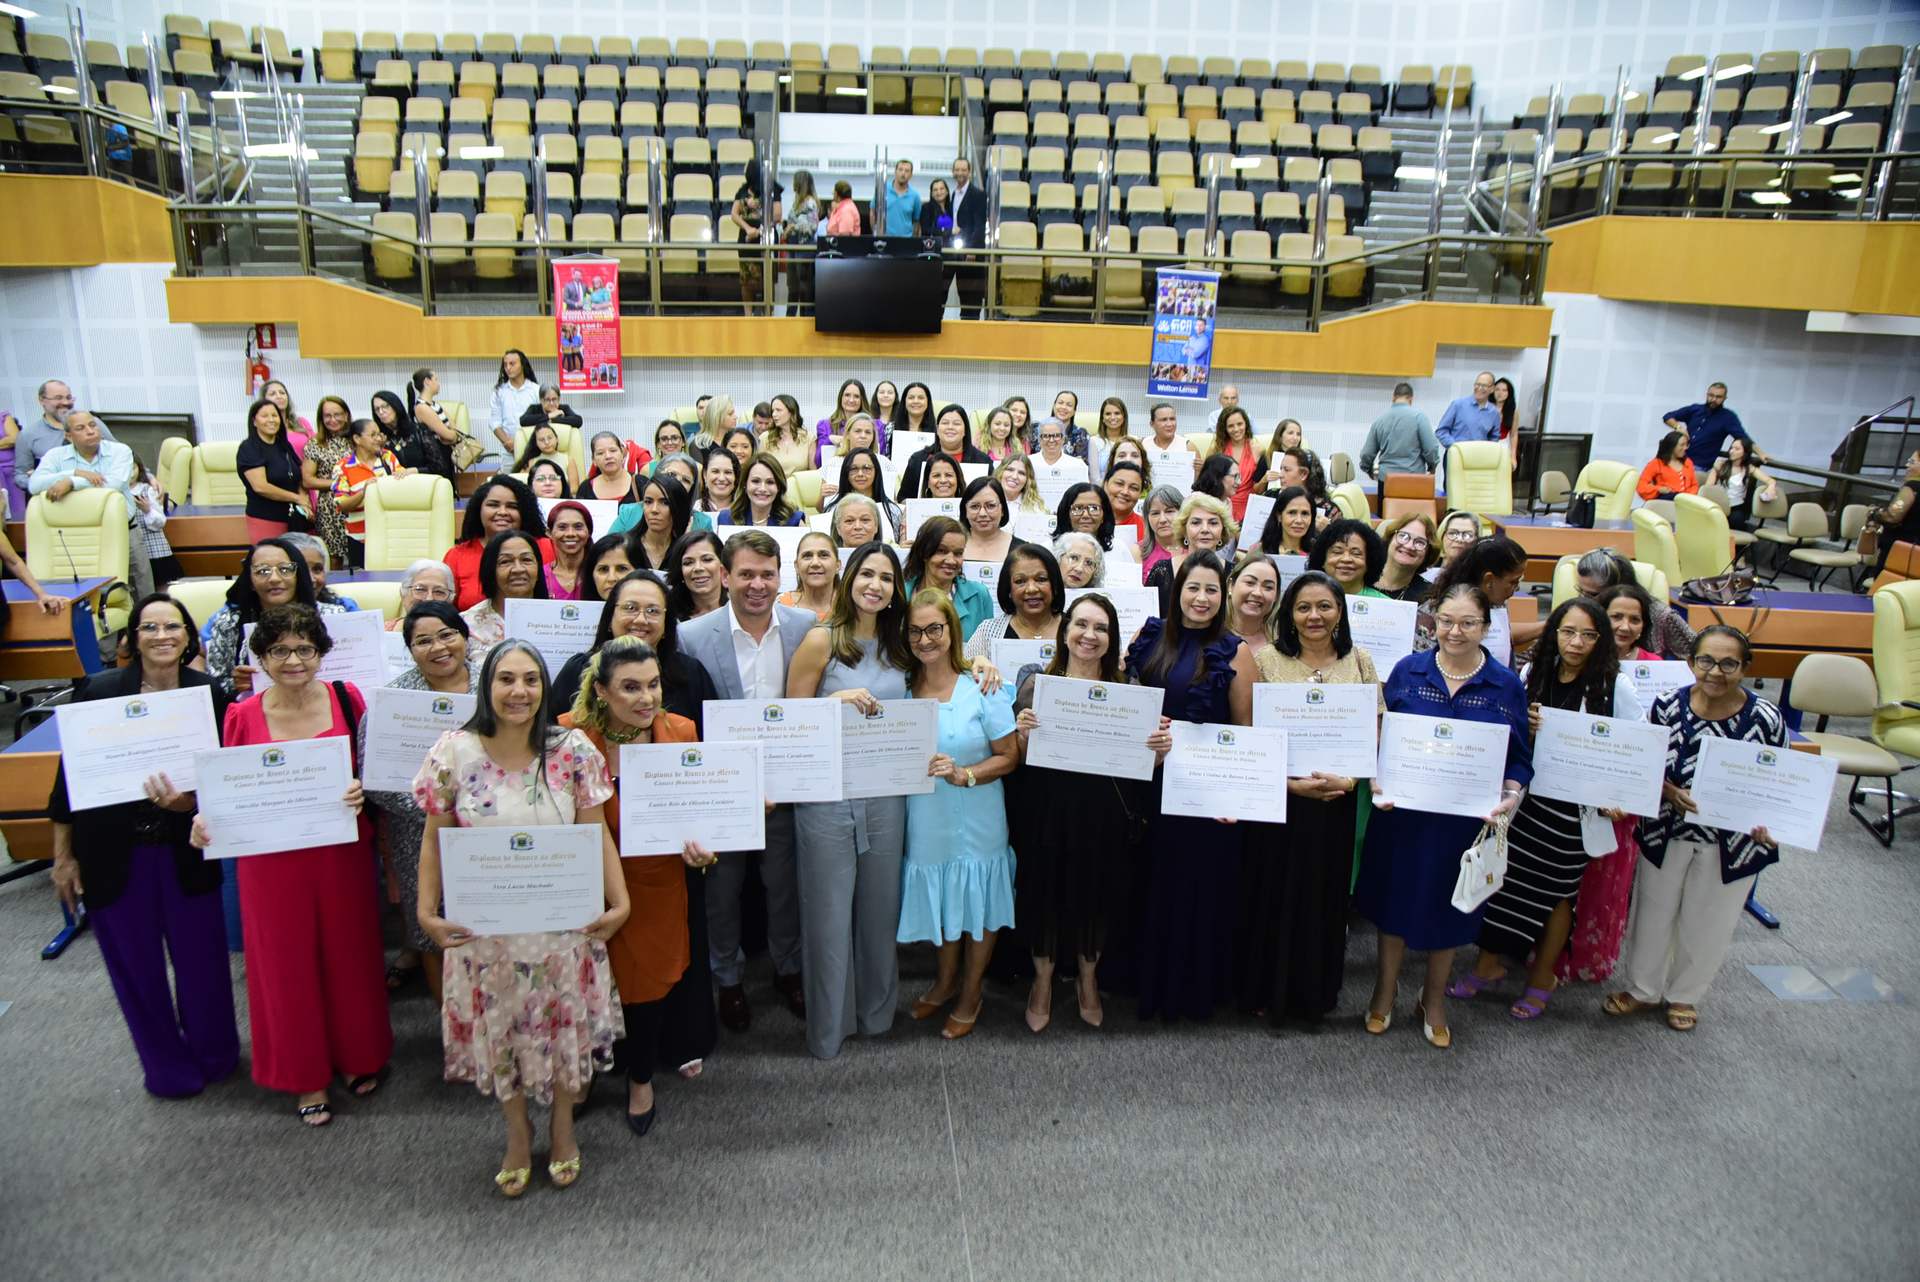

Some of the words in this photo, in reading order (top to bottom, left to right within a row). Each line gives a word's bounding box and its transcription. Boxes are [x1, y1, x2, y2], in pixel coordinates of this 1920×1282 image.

[1157, 384, 1178, 392] Welton
[1179, 386, 1198, 394] Lemos
[1054, 699, 1080, 707] Diploma
[433, 717, 454, 725] Honra
[1556, 732, 1582, 742] Diploma
[1592, 738, 1611, 747] Honra
[1622, 744, 1644, 752] Mérito
[223, 774, 255, 782] Diploma
[302, 765, 327, 774] Mérito
[716, 768, 740, 776] Mérito
[550, 852, 577, 860] Mérito
